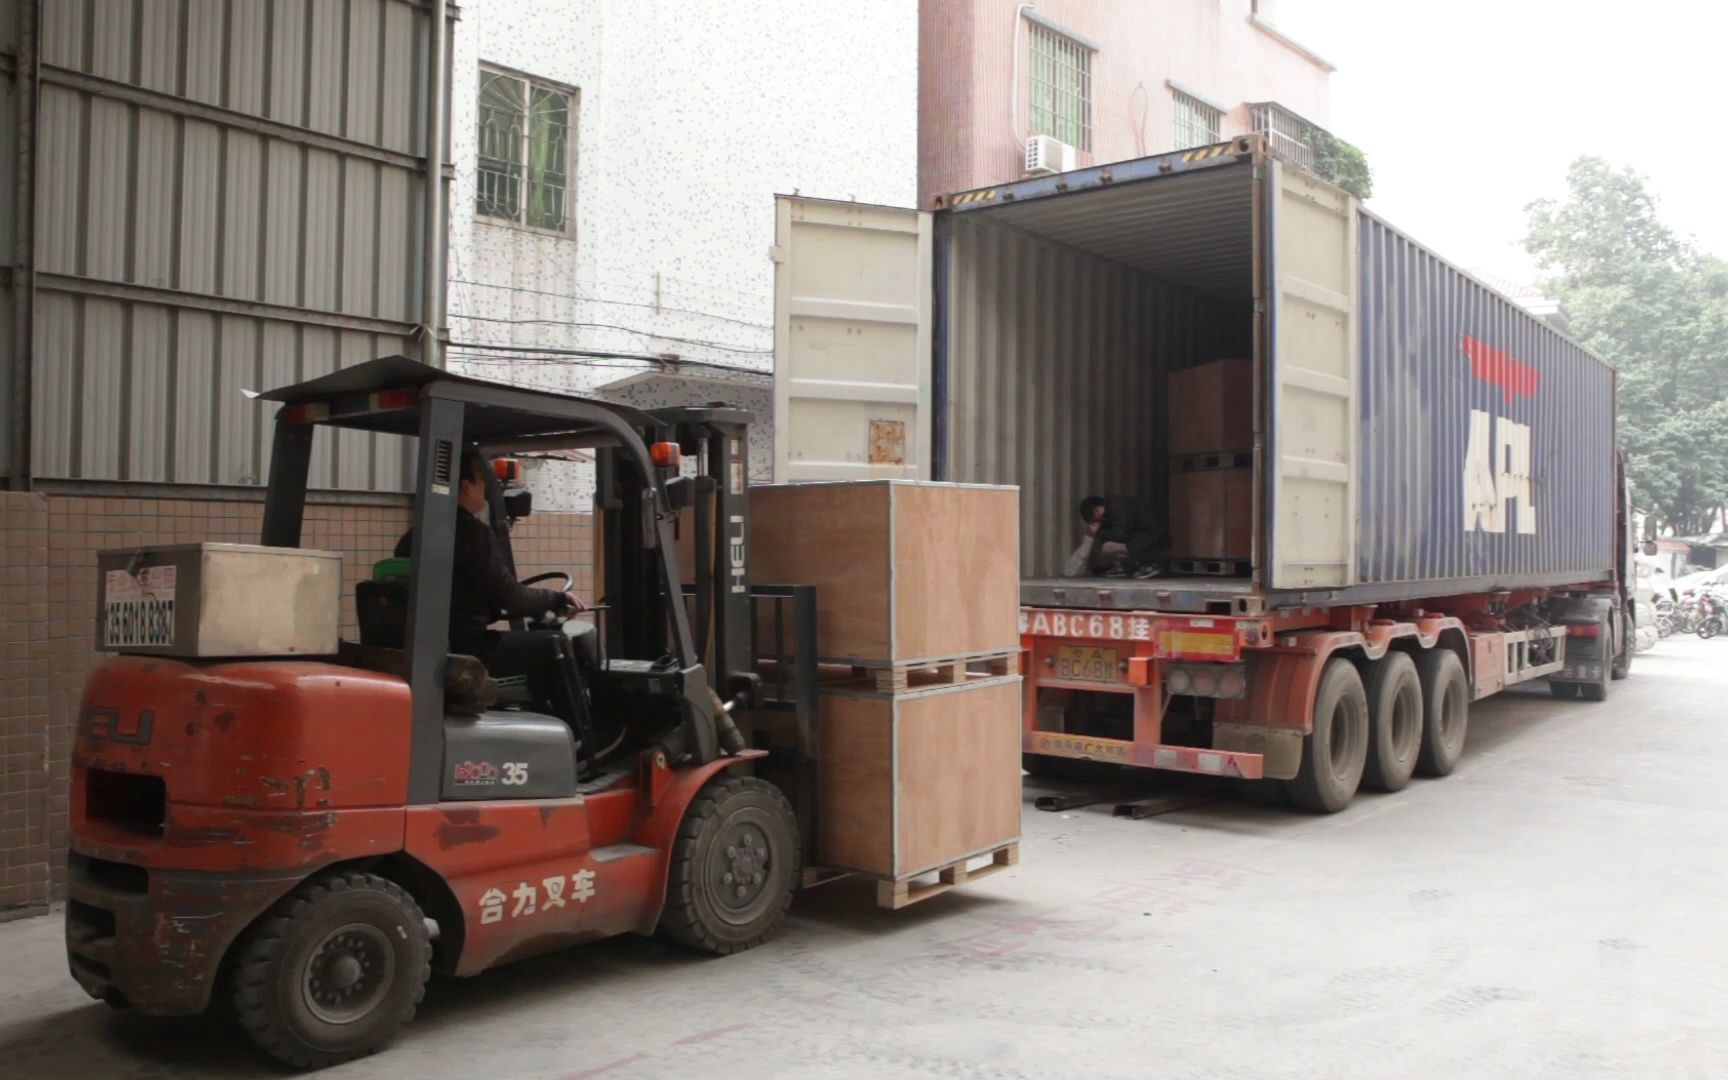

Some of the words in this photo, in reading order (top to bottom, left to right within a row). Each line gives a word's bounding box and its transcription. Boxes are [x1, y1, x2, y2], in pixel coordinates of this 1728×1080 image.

[1463, 409, 1536, 535] APL
[501, 762, 529, 786] 35
[479, 869, 596, 925] 合力叉车
